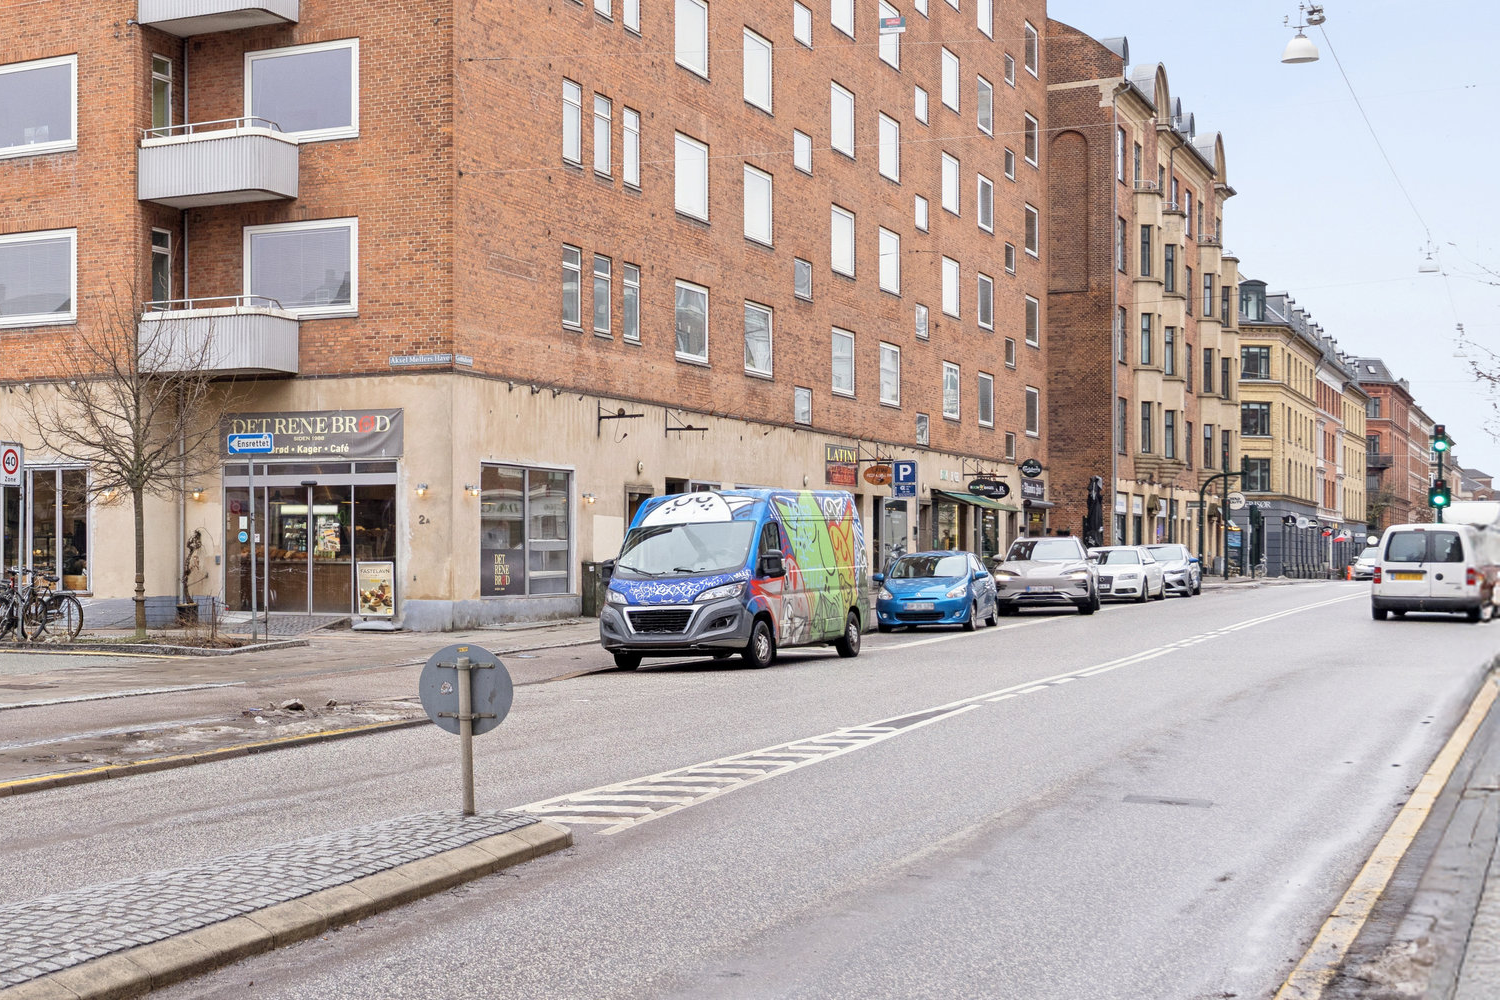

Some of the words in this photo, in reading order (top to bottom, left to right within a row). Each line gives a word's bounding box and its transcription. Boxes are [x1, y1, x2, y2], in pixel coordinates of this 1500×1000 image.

[391, 356, 408, 364] Aksel
[434, 354, 451, 362] Have
[232, 418, 270, 436] DET
[274, 417, 328, 435] RENE
[331, 415, 391, 434] BRØD
[237, 440, 270, 448] Ensrettet
[271, 445, 289, 454] rød
[297, 445, 323, 455] Kager
[330, 443, 350, 453] Café
[827, 447, 857, 464] LATINI
[5, 456, 17, 467] 40
[899, 464, 912, 482] P
[418, 514, 431, 525] 2A
[494, 553, 506, 565] DET
[494, 564, 510, 575] RENE
